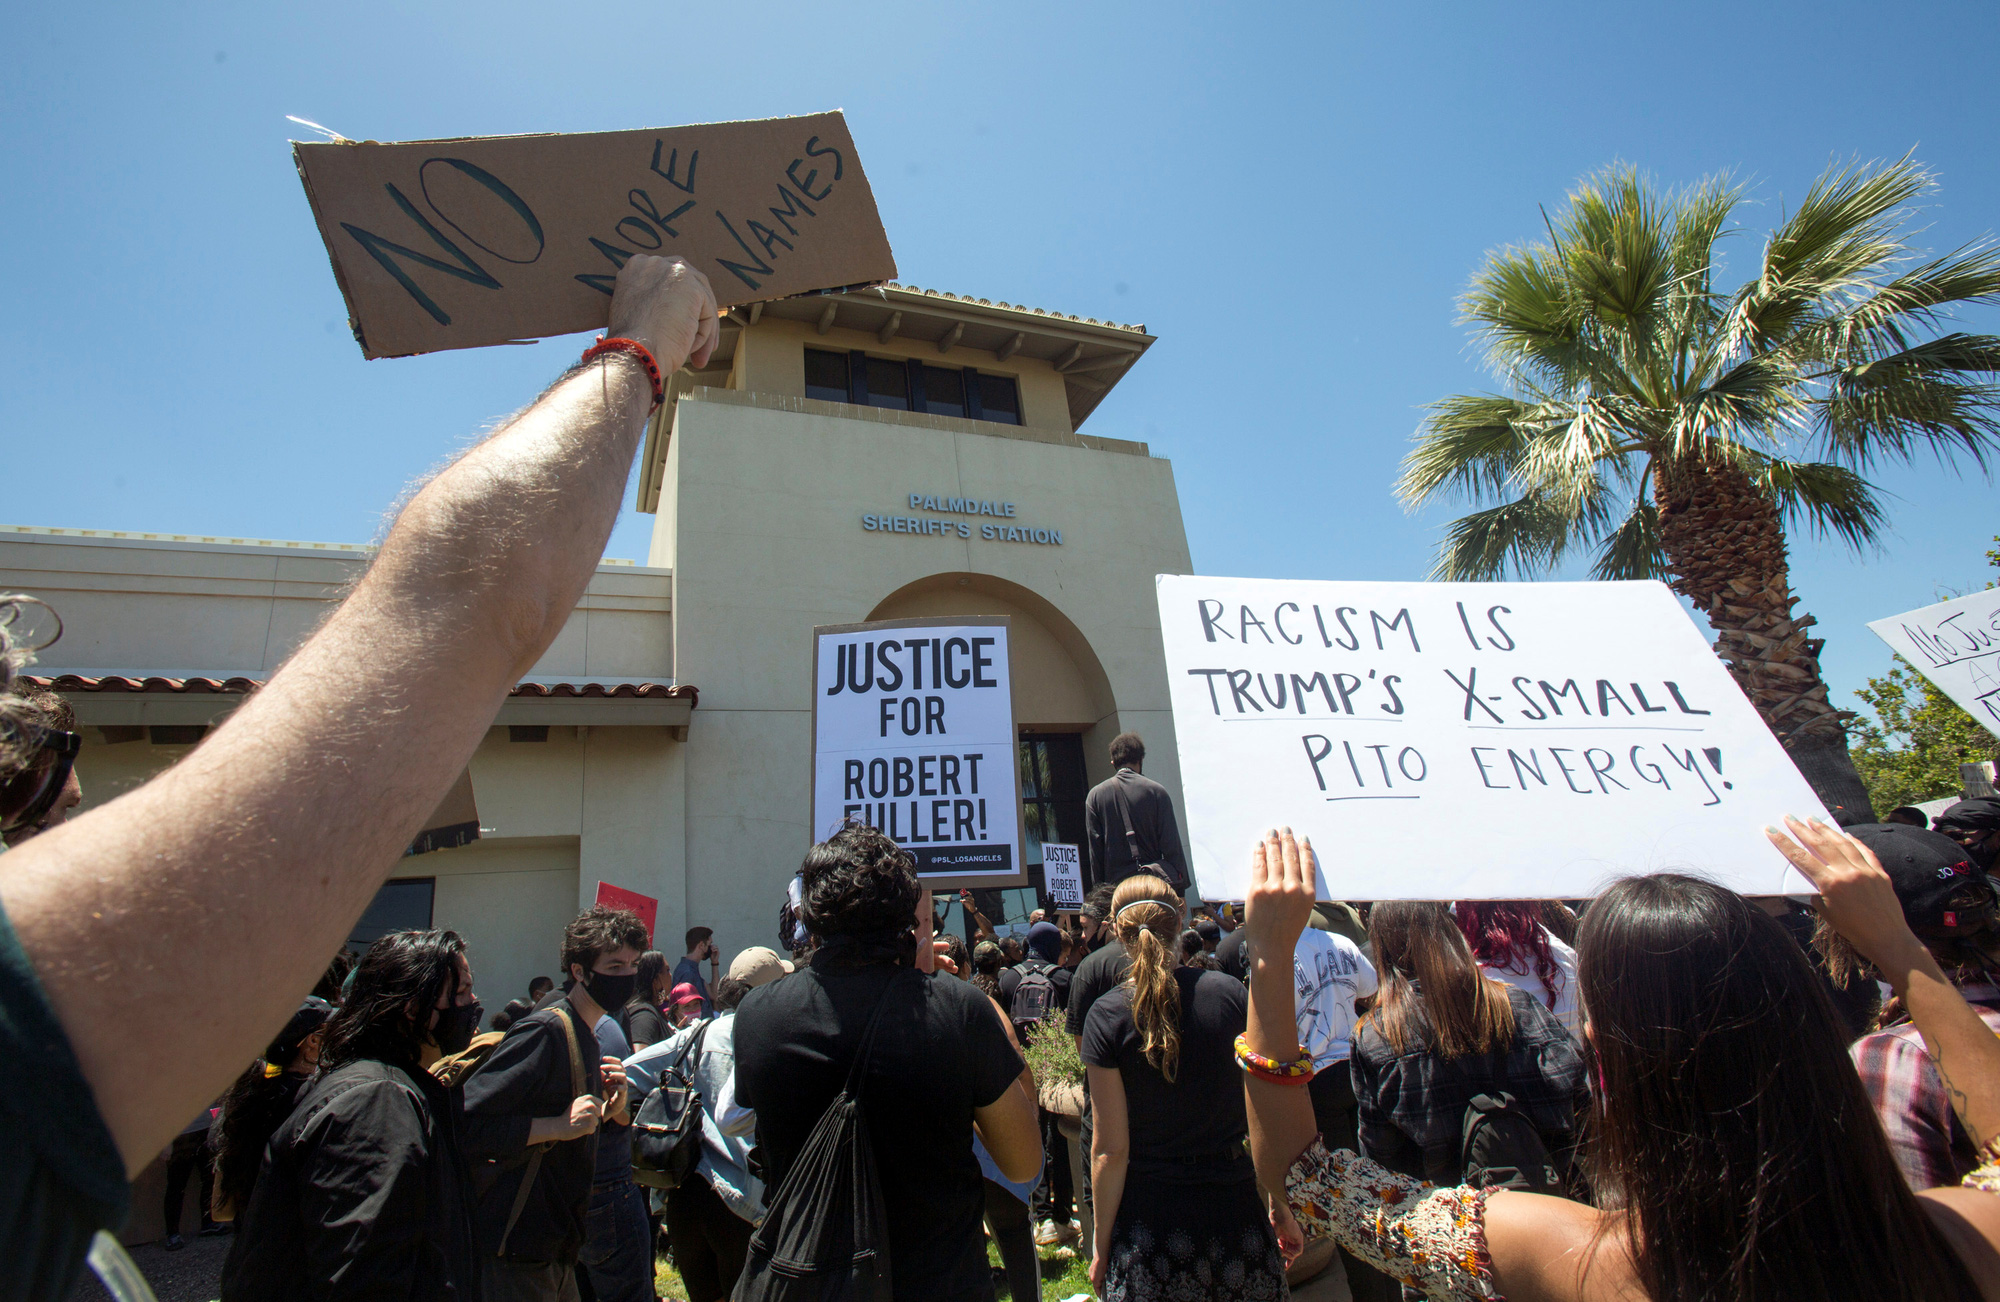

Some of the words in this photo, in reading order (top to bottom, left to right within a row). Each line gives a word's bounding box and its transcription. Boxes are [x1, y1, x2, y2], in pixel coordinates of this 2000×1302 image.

[716, 136, 843, 291] NAMES
[340, 157, 545, 326] NO
[908, 493, 1017, 518] PALMDALE
[862, 514, 971, 538] SHERIFF'S
[981, 523, 1063, 545] STATION
[1197, 599, 1421, 652] RACISM
[1455, 601, 1516, 652] IS
[827, 637, 997, 696] JUSTICE
[880, 696, 947, 737] FOR
[1188, 668, 1404, 716] TRUMP'S
[1444, 667, 1711, 724] X-SMALL
[844, 753, 983, 800] ROBERT
[1302, 734, 1427, 791] PITO
[1471, 743, 1734, 807] ENERGY!
[844, 798, 987, 843] FULLER!
[931, 854, 1002, 864] @PSL_LOSANGELES
[1045, 846, 1077, 863] JUSTICE
[1055, 863, 1070, 874] FOR
[1051, 878, 1077, 890] ROBERT
[1052, 890, 1079, 902] FULLER!
